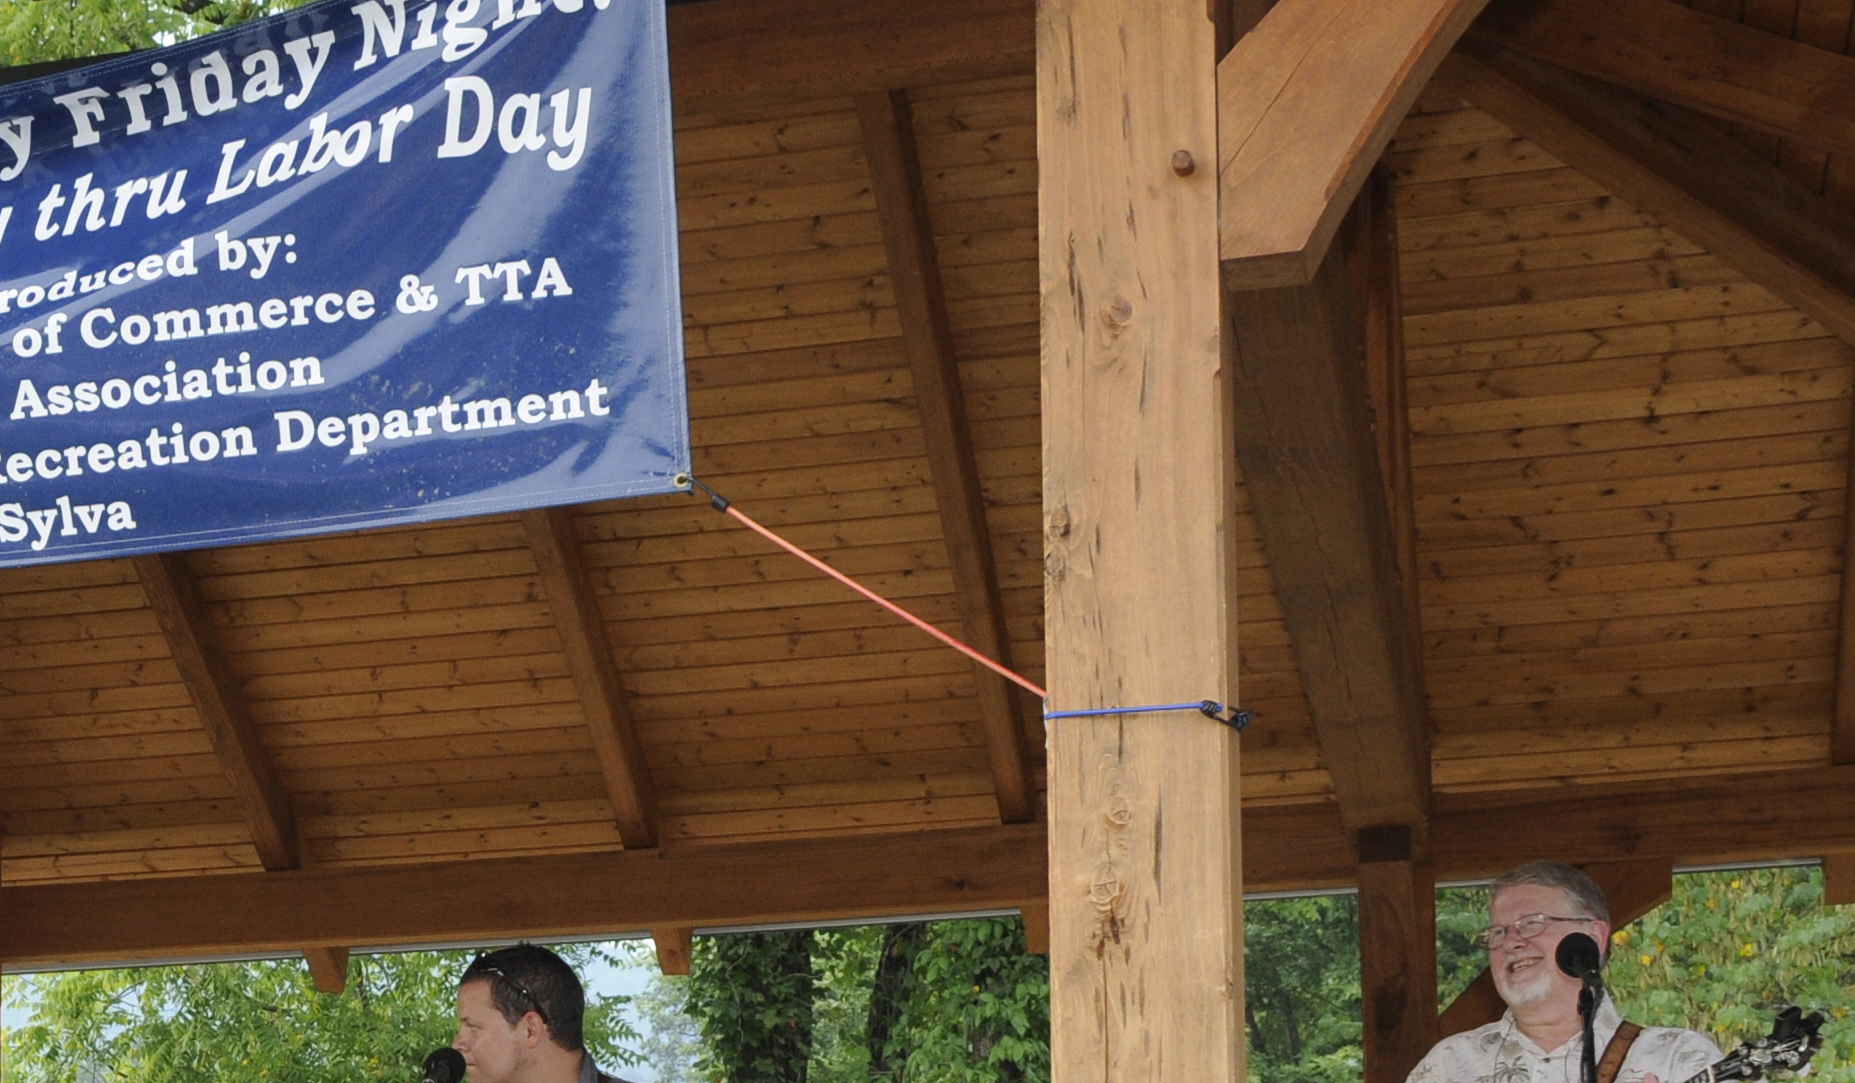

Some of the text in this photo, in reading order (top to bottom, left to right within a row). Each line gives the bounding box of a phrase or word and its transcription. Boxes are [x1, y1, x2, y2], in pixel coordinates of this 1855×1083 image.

[55, 30, 336, 148] Friday
[35, 170, 187, 240] thru
[207, 104, 414, 204] Labor
[438, 76, 591, 171] Day
[215, 230, 296, 278] by:
[13, 312, 67, 357] of
[80, 287, 375, 349] Commerce
[397, 275, 438, 314] &
[455, 258, 572, 306] TTA
[11, 352, 325, 420] Association
[274, 379, 609, 455] Department
